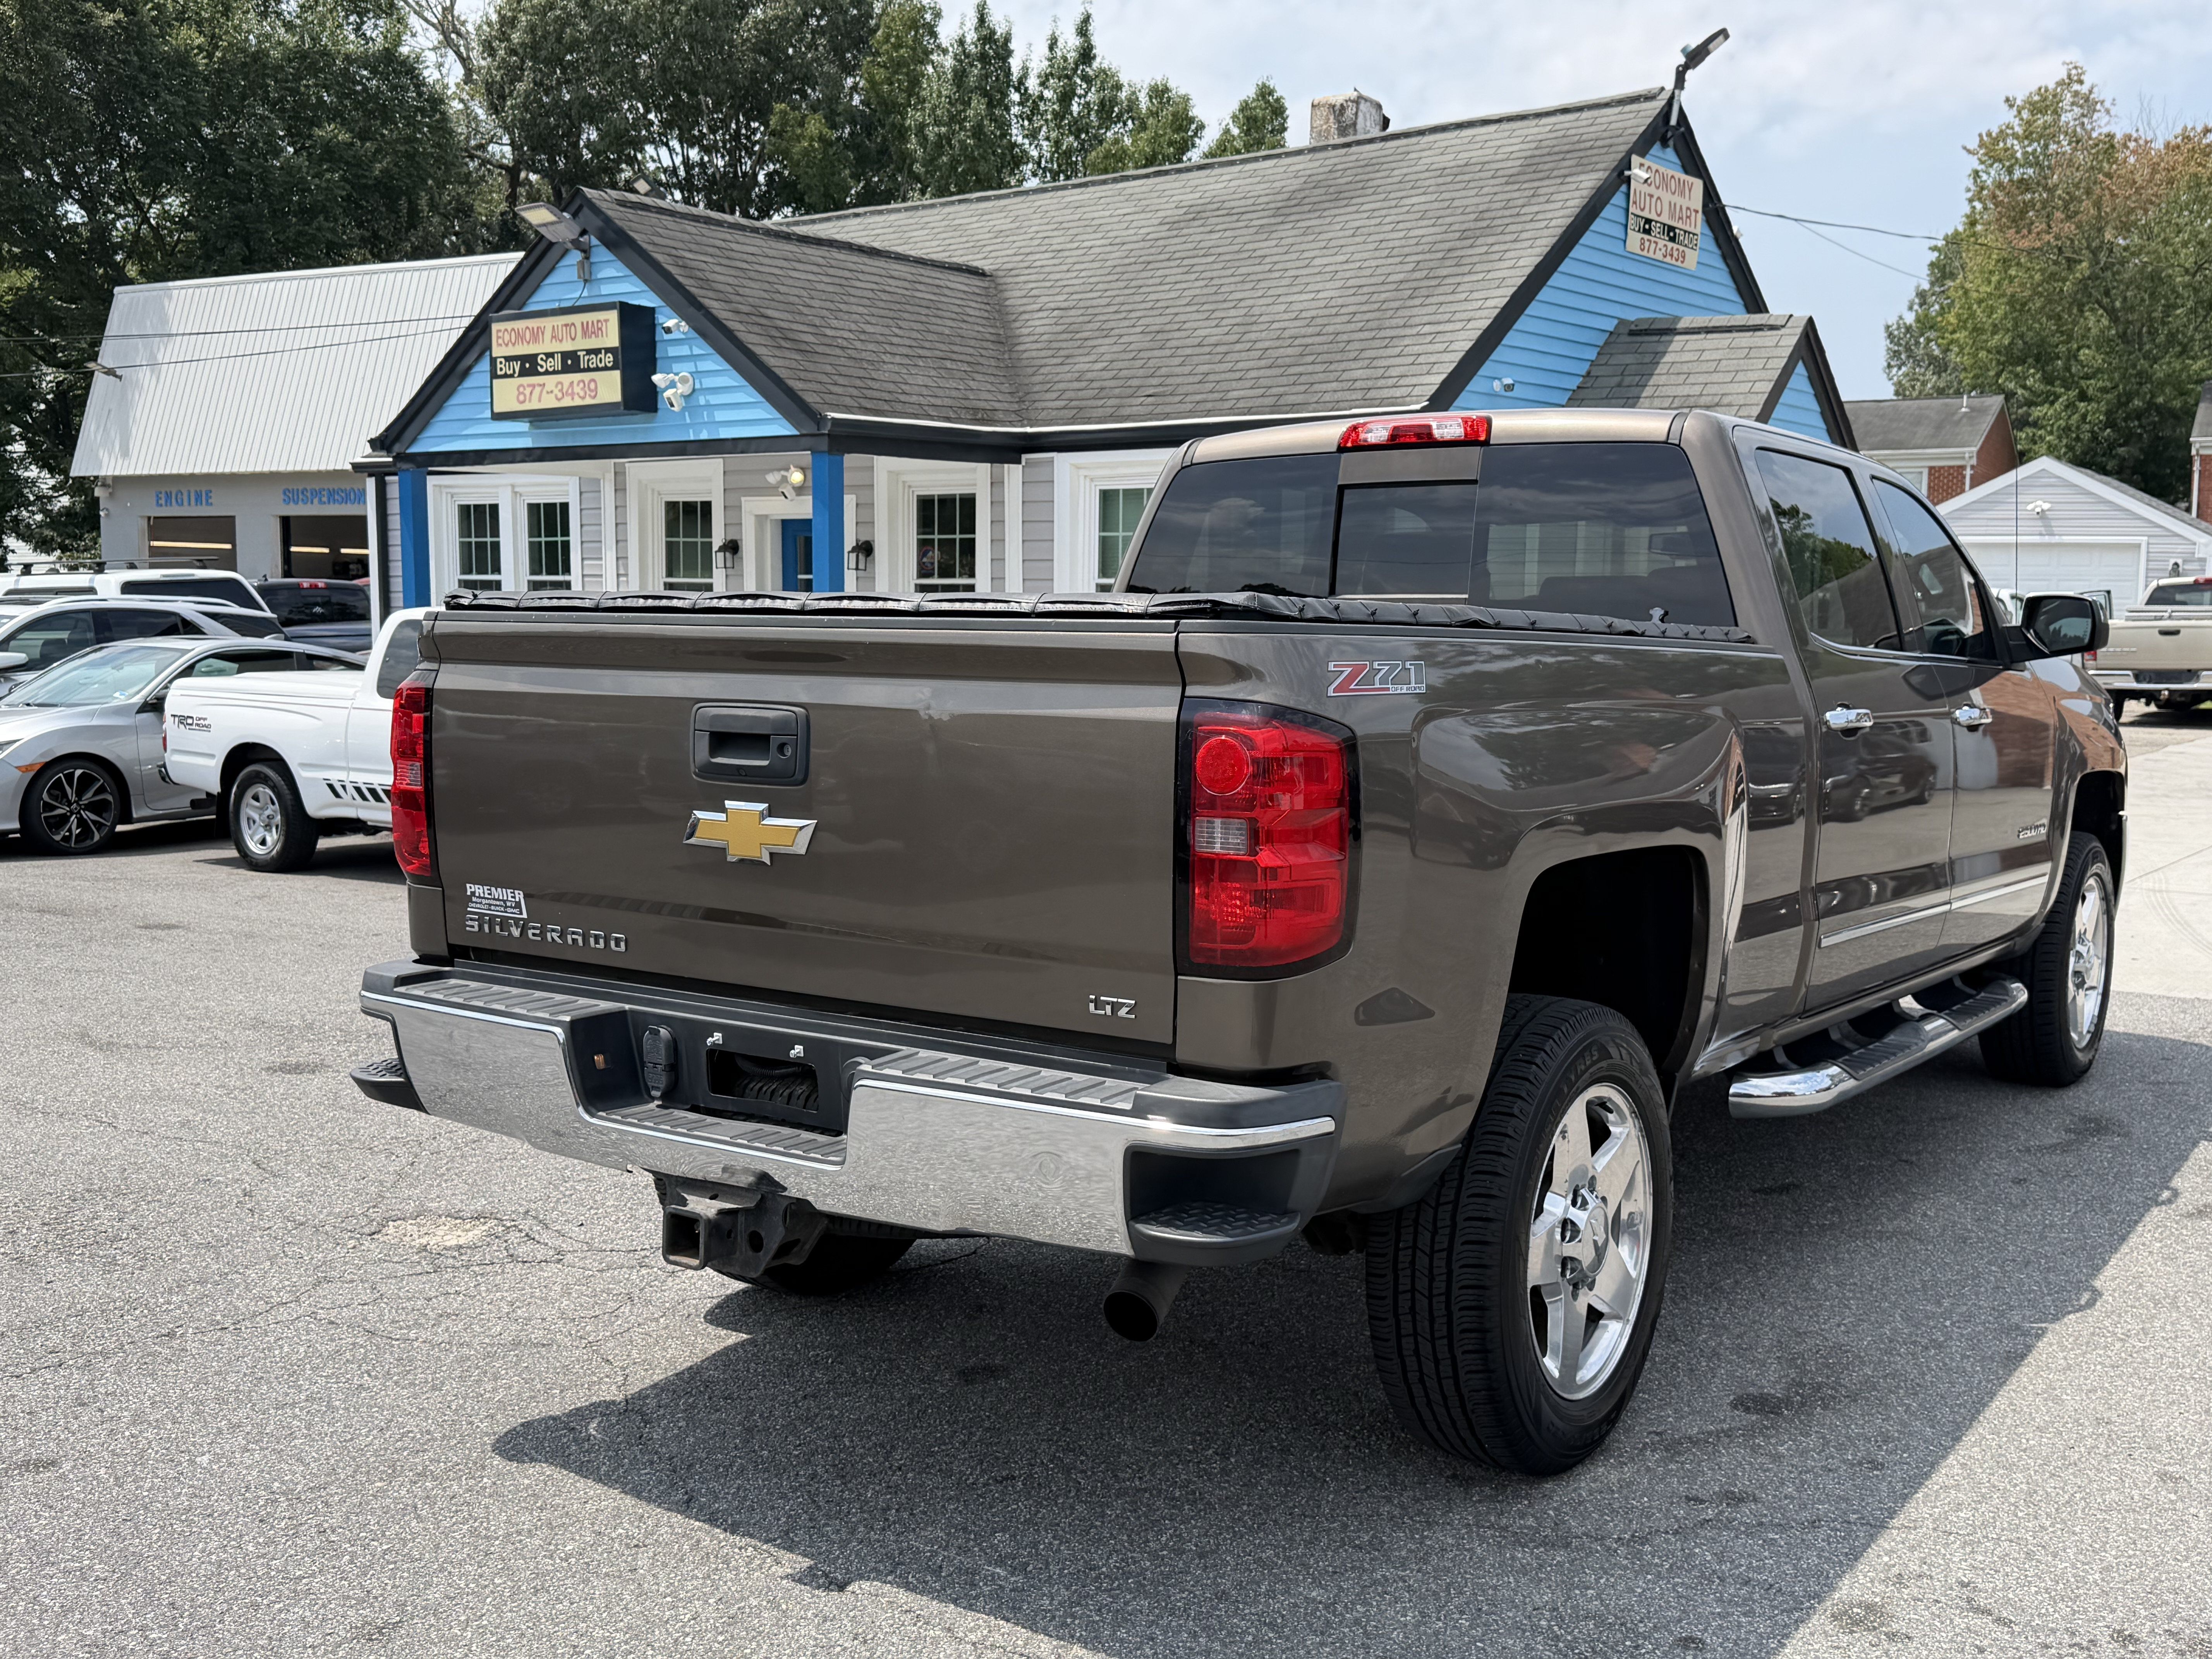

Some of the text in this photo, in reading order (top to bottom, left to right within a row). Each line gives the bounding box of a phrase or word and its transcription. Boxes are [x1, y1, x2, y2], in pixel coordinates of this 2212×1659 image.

[1631, 188, 1699, 229] AUTO MART
[1631, 215, 1698, 249] BUY SELL TRADE
[1639, 237, 1686, 264] 877-3439
[496, 319, 610, 347] ECONOMY AUTO MART
[496, 349, 613, 377] Buy Sell Trade
[516, 378, 598, 404] 877-3439
[155, 489, 213, 507] ENGINE
[282, 487, 366, 505] SUSPENSION
[1327, 660, 1426, 696] Z71
[170, 714, 194, 730] TRD
[466, 883, 524, 902] PREMIER
[465, 914, 627, 952] SILVERADO
[1089, 995, 1135, 1018] LTZ
